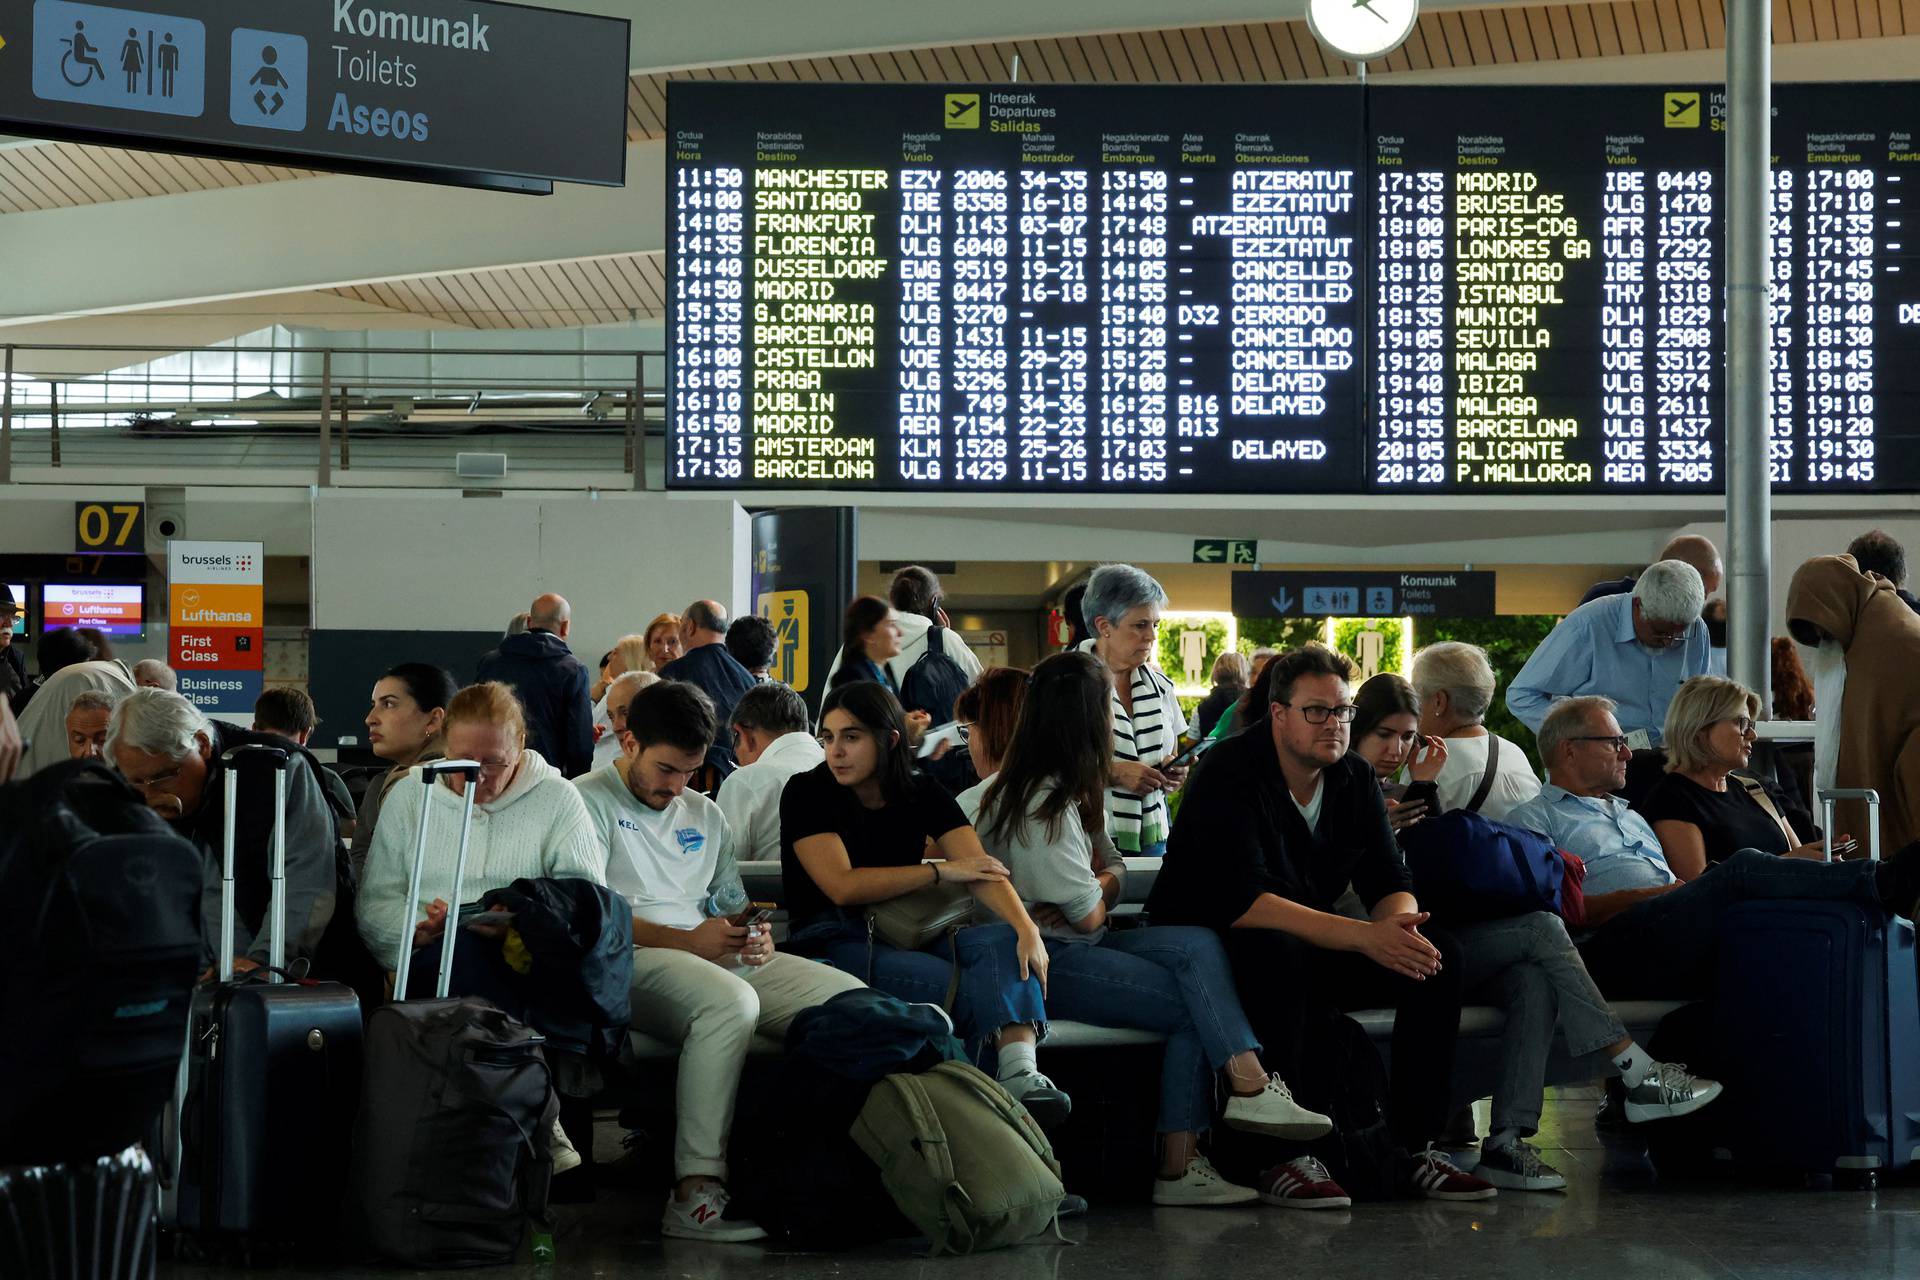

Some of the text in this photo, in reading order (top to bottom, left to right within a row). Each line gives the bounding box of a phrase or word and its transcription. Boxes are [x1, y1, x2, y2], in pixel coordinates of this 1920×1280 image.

[333, 0, 490, 52] Komunak
[332, 45, 417, 88] Toilets
[989, 92, 1036, 104] Irteerak
[327, 92, 429, 142] Aseos
[989, 105, 1057, 119] Departures
[989, 120, 1041, 133] Salidas
[676, 131, 704, 140] Ordua
[756, 131, 803, 141] Norabidea
[902, 133, 942, 143] Hegaldia
[1022, 134, 1055, 142] Mahaia
[1102, 133, 1170, 143] Hegazkineratze
[1235, 133, 1271, 142] Oharrak
[1377, 135, 1405, 144] Ordua
[1457, 135, 1504, 145] Norabidea
[1605, 135, 1645, 145] Hegaldia
[1806, 132, 1876, 142] Hegazkineratze
[677, 141, 699, 149] Time
[757, 141, 804, 150] Destination
[902, 142, 927, 152] Flight
[1102, 143, 1140, 153] Boarding
[1182, 143, 1203, 152] Gate
[1235, 143, 1274, 152] Remarks
[1378, 145, 1401, 154] Time
[1457, 145, 1506, 154] Destination
[1605, 145, 1630, 155] Flight
[1806, 143, 1846, 153] Boarding
[1888, 141, 1910, 151] Gate
[676, 151, 701, 161] Hora
[756, 151, 798, 161] Destino
[903, 152, 934, 162] Vuelo
[1022, 153, 1076, 163] Mostrador
[1101, 153, 1156, 165] Embarque
[1181, 153, 1216, 163] Puerta
[1235, 153, 1310, 164] Observaciones
[1377, 155, 1402, 165] Hora
[1457, 155, 1499, 165] Destino
[1606, 155, 1637, 165] Vuelo
[1806, 153, 1862, 164] Embarque
[678, 168, 1353, 190] 11:50 MANCHESTER EZY 2006 ATZERATUT
[1379, 172, 1711, 192] 17:35 MADRID IBE 0449
[678, 190, 1353, 212] 14:00 SANTIAGO IBE 8358 EZEZTATUT
[1379, 194, 1711, 214] 17:45 BRUSELAS VLG 1470
[678, 213, 1326, 235] 14:05 FRANKFURT DLH 1143 ATZERATUTA
[1379, 216, 1711, 236] 18:00 PARIS-CDG AFR 1577
[678, 235, 1352, 257] 14:35 FLORENCIA VLG 6040 EZEZTATUT
[1379, 239, 1711, 259] 18:05 LONDRES GA VLG 7292
[678, 258, 1352, 280] 14:40 DUSSELDORF EWG 9519 CANCELLED
[1379, 263, 1563, 281] 18:10 SANTIAGO
[677, 280, 1352, 302] 14:50 MADRID CANCELLED
[1379, 285, 1563, 304] 18:25 ISTANBUL
[677, 302, 1325, 325] 15:35 G.CANARIA D32 CERRADO
[1378, 307, 1536, 326] 18:35 MUNICH
[677, 324, 1352, 347] 15:55 BARCELONA CANCELADO
[1378, 329, 1549, 348] 19:05 SEVILLA
[677, 347, 1352, 370] 16:00 CASTELLON CANCELLED
[1378, 352, 1536, 371] 19:20 MALAGA
[677, 369, 1326, 392] 16:05 PRAGA DELAYED
[1378, 374, 1523, 393] 19:40 IBIZA
[677, 392, 1325, 415] 16:10 DUBLIN B16 DELAYED
[1379, 397, 1537, 416] 19:45 MALAGA
[677, 414, 1219, 436] 16:50 MADRID A13
[1379, 419, 1577, 438] 19:55 BARCELONA
[677, 437, 1326, 459] 17:15 AMSTERDAM DELAYED
[1378, 441, 1564, 460] 20:05 ALICANTE
[677, 459, 874, 478] 17:30 BARCELONA
[1378, 464, 1591, 482] 20:20 P.MALLORCA
[79, 505, 140, 546] 07
[182, 554, 231, 565] brussels
[1400, 574, 1457, 586] Komunak
[1400, 588, 1432, 599] Toilets
[79, 605, 123, 615] Lufthansa
[181, 609, 252, 622] Lufthansa
[181, 635, 212, 647] First
[181, 650, 219, 662] Class
[181, 678, 243, 690] Business
